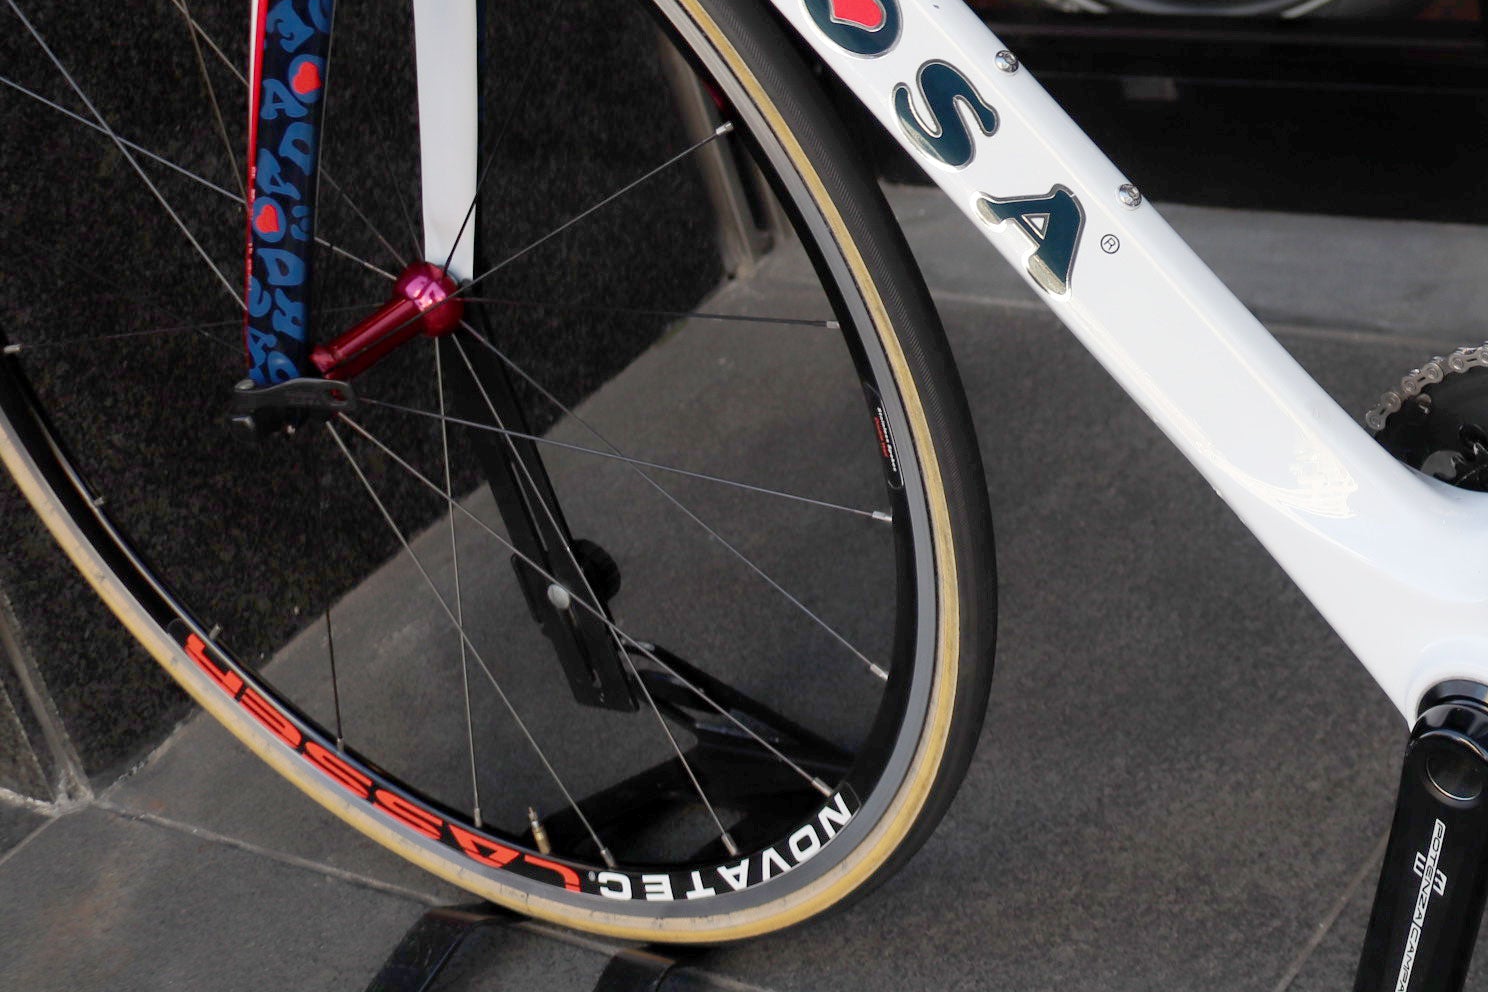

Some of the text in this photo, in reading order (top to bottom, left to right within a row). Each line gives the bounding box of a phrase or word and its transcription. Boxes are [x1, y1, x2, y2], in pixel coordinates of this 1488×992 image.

[184, 632, 582, 893] LASSER
[598, 792, 852, 901] NOVATEC
[1397, 820, 1445, 992] POTENZA CAMPA
